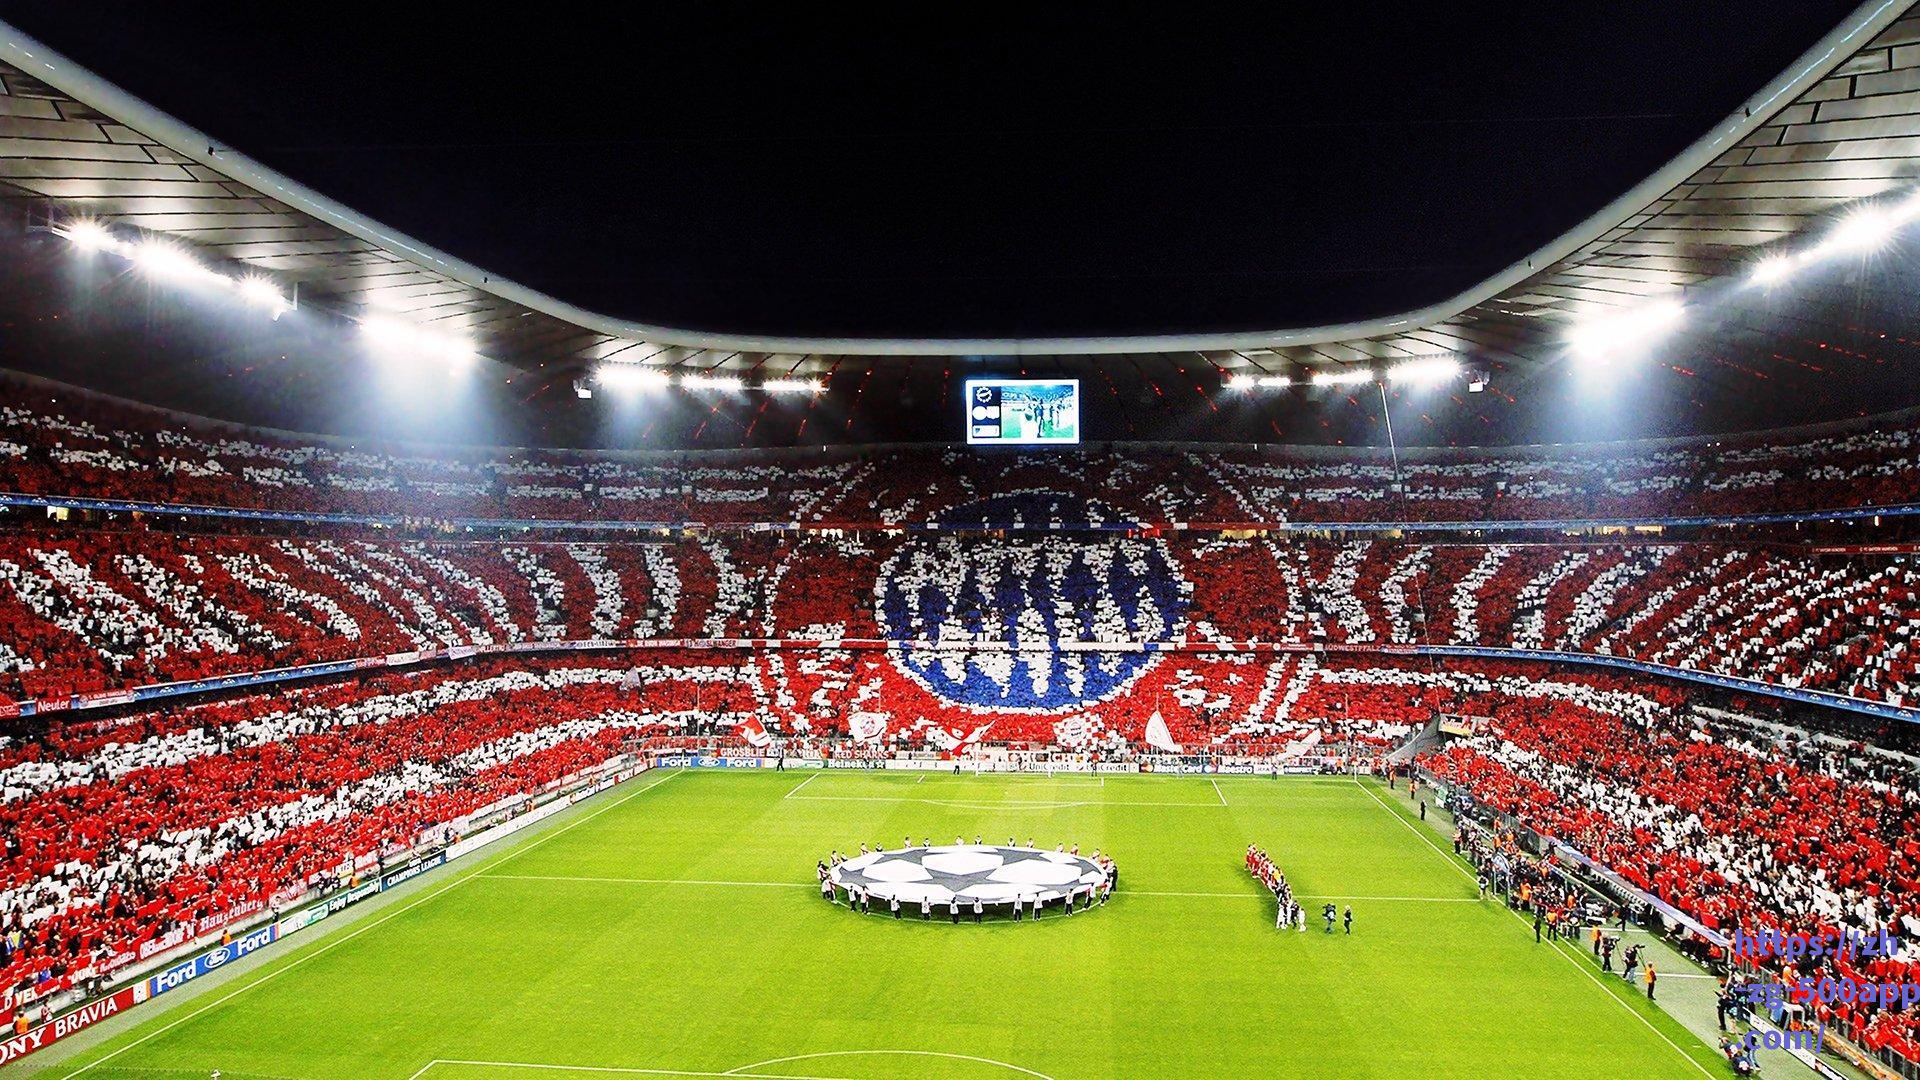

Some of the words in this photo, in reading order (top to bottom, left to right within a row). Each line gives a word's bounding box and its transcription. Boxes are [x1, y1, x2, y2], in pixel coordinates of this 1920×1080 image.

[38, 699, 69, 713] Neuler
[726, 758, 757, 768] Ford
[329, 896, 346, 911] Enjoy
[238, 928, 270, 955] Ford
[157, 959, 197, 993] Ford
[55, 997, 118, 1039] BRAVIA
